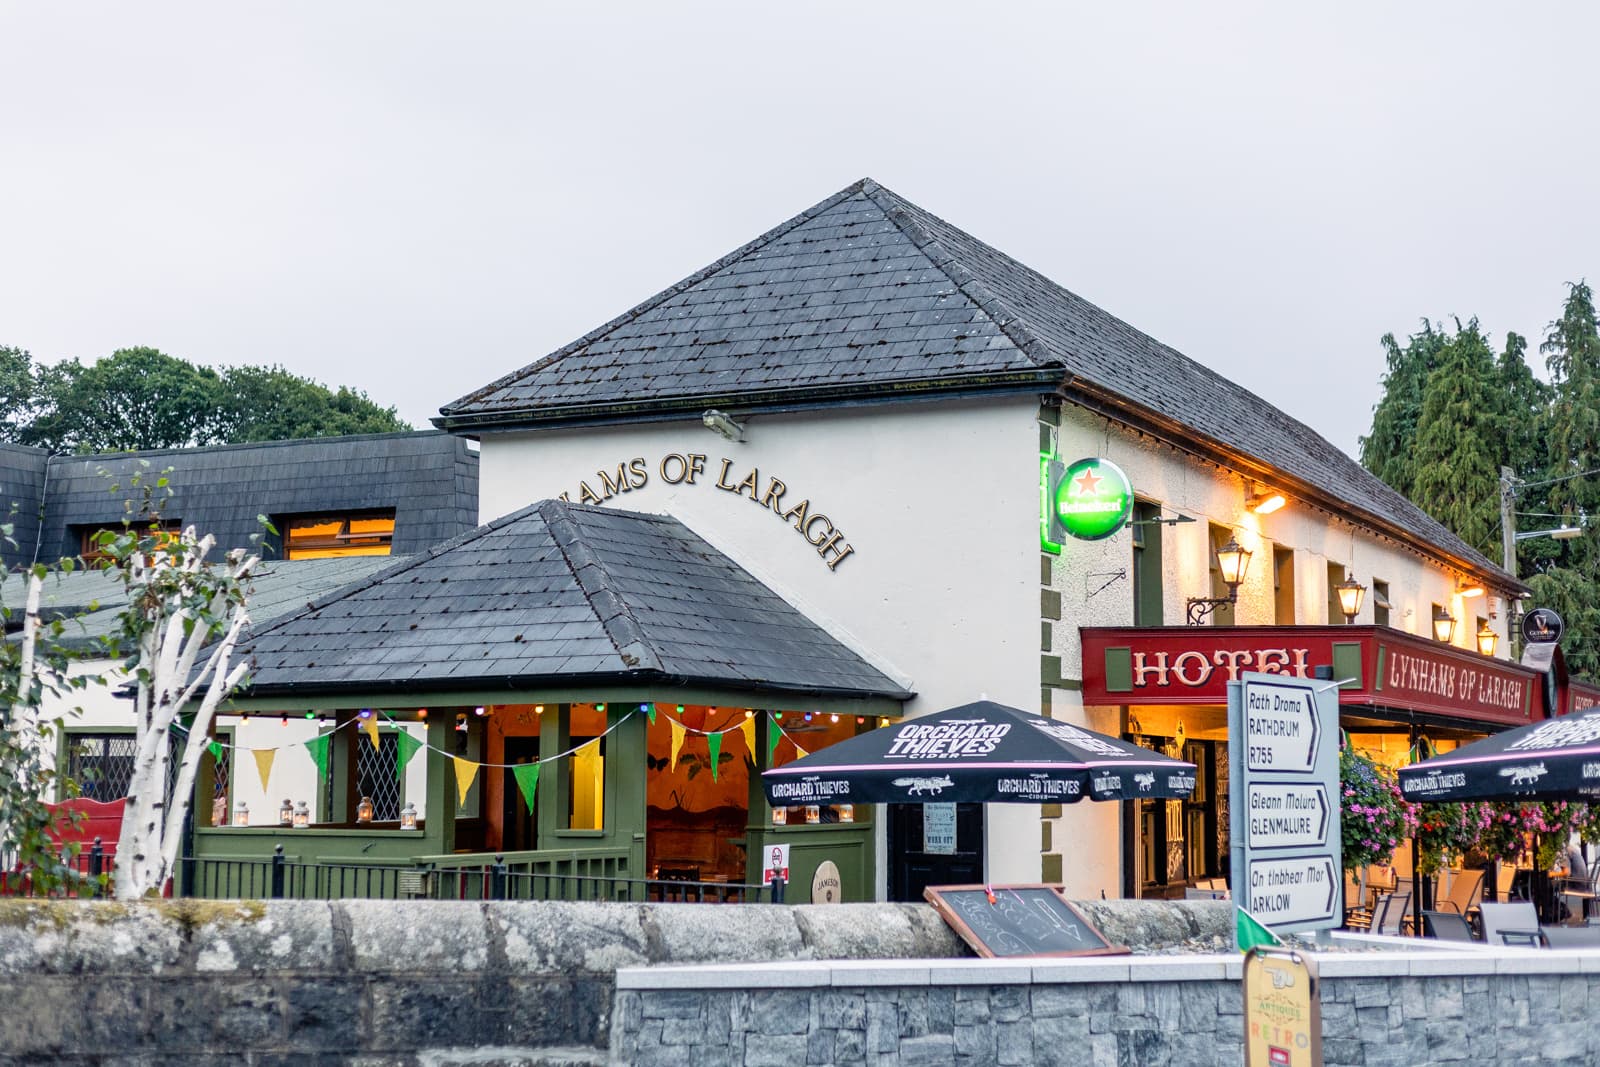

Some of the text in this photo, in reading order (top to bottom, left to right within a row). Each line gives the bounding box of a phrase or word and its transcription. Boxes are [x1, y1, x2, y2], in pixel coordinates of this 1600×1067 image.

[659, 453, 706, 485] OF
[715, 457, 854, 572] LARAGH
[1133, 648, 1309, 686] HOTEL
[1389, 652, 1522, 710] LYNHAMS OF LARAGH
[1249, 692, 1301, 713] Rath Droma
[897, 723, 1012, 739] ORCHARD
[1249, 718, 1300, 737] RATHDRUM
[888, 737, 1002, 754] THIEVES
[1250, 746, 1273, 764] R755
[772, 780, 850, 798] ORCHARD THIEVES
[998, 778, 1042, 793] ORCHARD
[1042, 779, 1080, 795] THIEVES
[1404, 773, 1466, 792] ORCHARD THIEVES
[1251, 792, 1281, 810] Gleann
[1251, 817, 1311, 835] GLENMALURE
[818, 879, 839, 891] JAMESON
[1253, 894, 1291, 914] ARKLOW
[1259, 1001, 1302, 1021] ANTIQUES
[1251, 1022, 1309, 1049] RETRO
